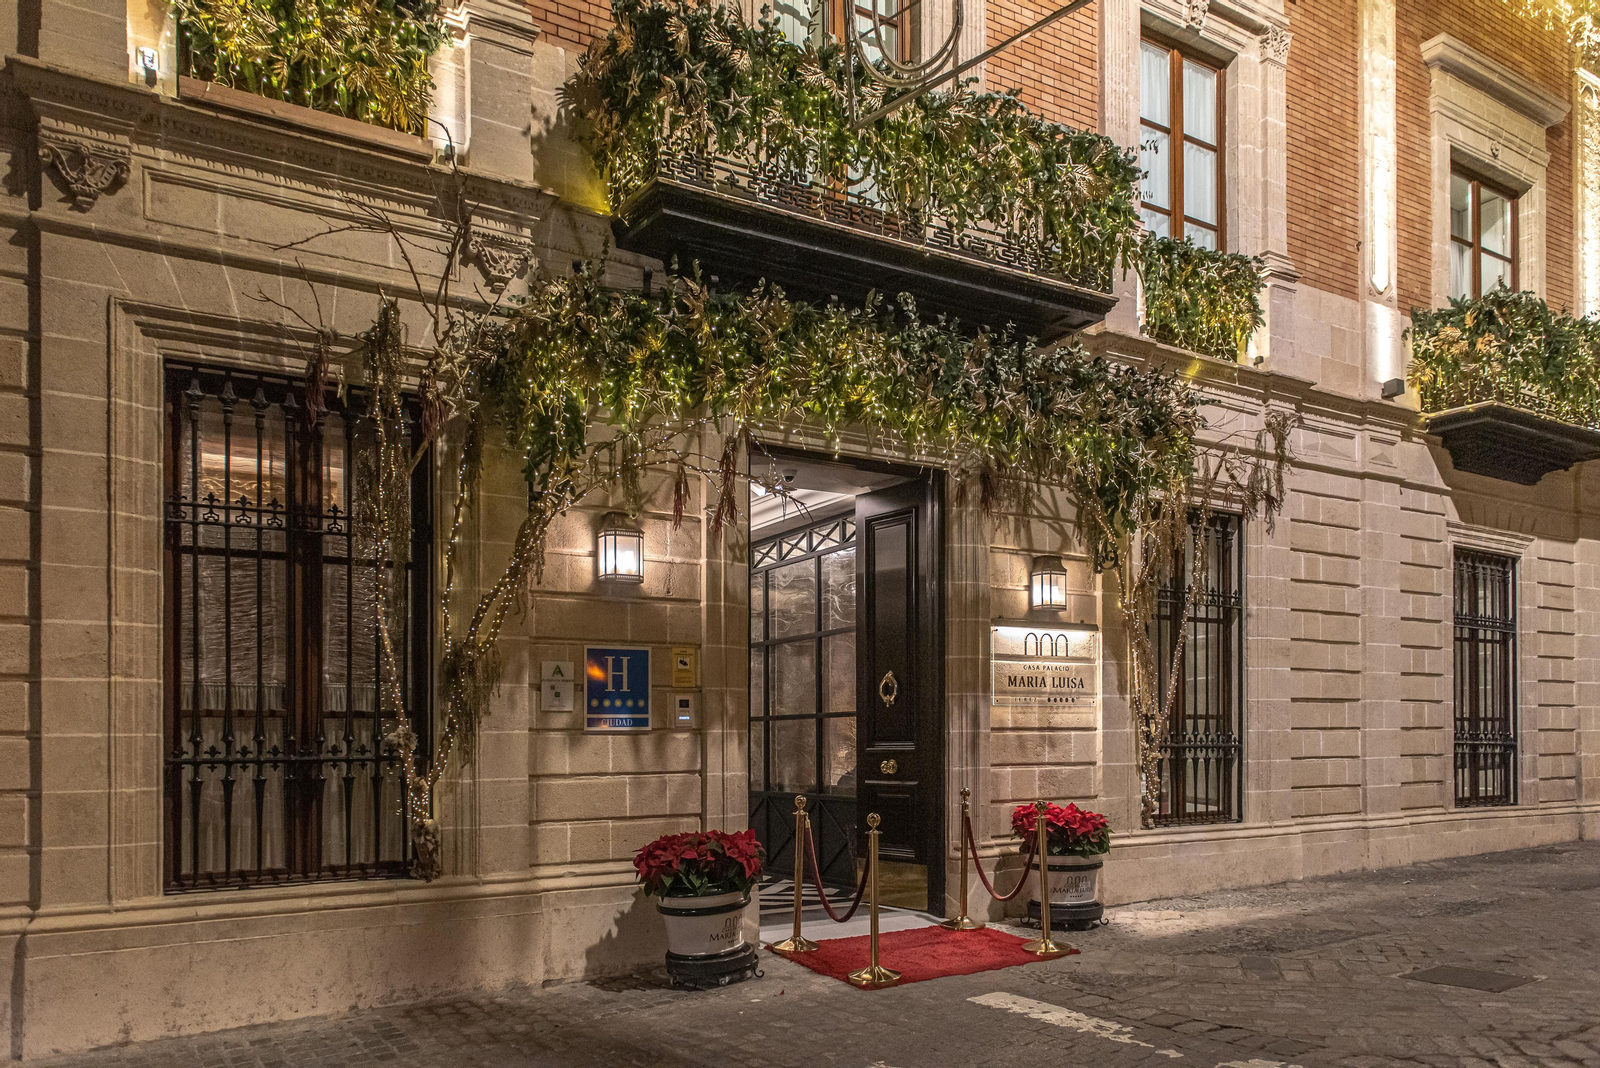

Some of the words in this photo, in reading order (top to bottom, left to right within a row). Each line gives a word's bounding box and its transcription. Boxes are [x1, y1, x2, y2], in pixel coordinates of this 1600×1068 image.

[605, 656, 630, 691] H
[1007, 675, 1047, 688] MARIA
[1052, 677, 1085, 689] LUISA
[601, 719, 633, 727] CIUDAD
